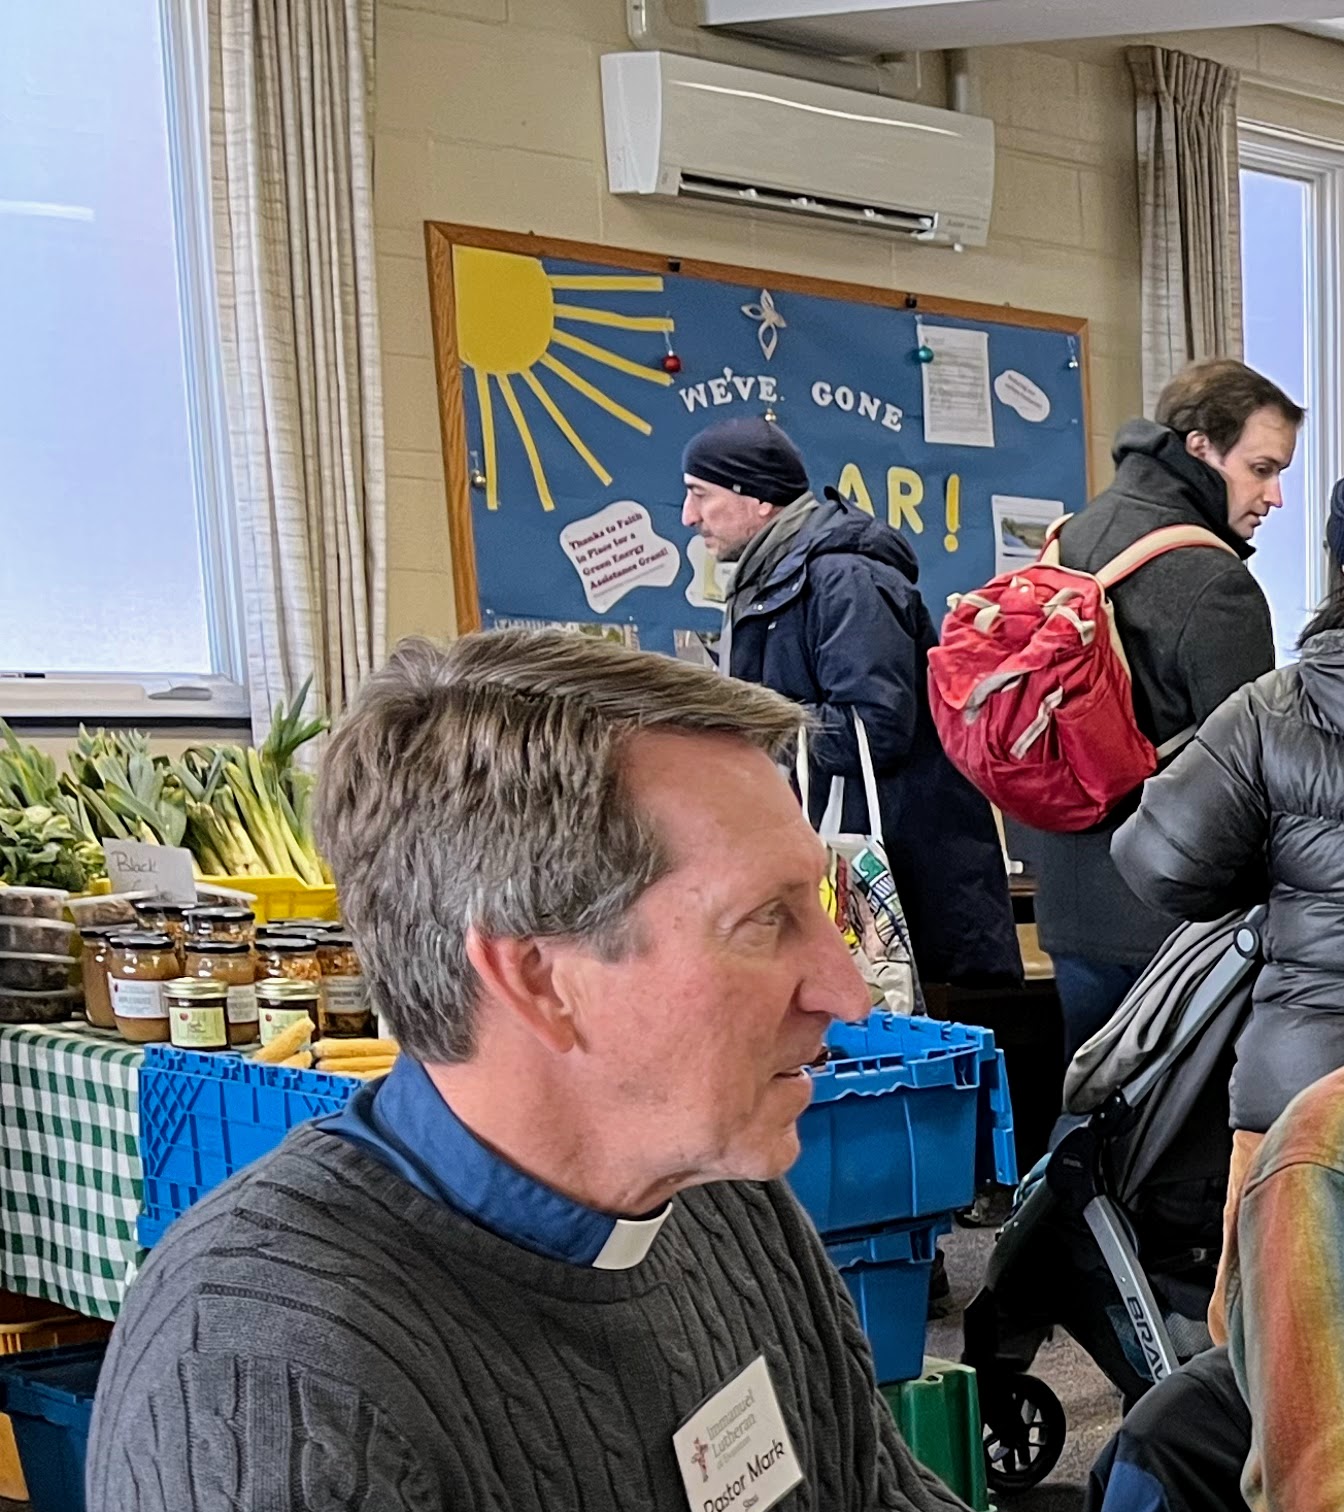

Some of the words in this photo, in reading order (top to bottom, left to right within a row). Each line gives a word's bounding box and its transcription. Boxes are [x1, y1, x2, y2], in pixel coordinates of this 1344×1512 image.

[679, 367, 777, 413] WE'VE
[811, 381, 903, 432] GONE
[837, 462, 960, 552] AR!
[569, 530, 604, 550] Thanks
[606, 525, 615, 533] to
[617, 513, 643, 529] Faith
[576, 555, 586, 563] in
[588, 543, 612, 559] Place
[613, 535, 627, 546] for
[583, 561, 611, 576] Green
[612, 544, 644, 563] Energy
[590, 564, 637, 590] Assistance
[706, 1390, 756, 1441] Immanuel
[711, 1412, 757, 1459] Lutheran
[746, 1439, 786, 1483] Mark
